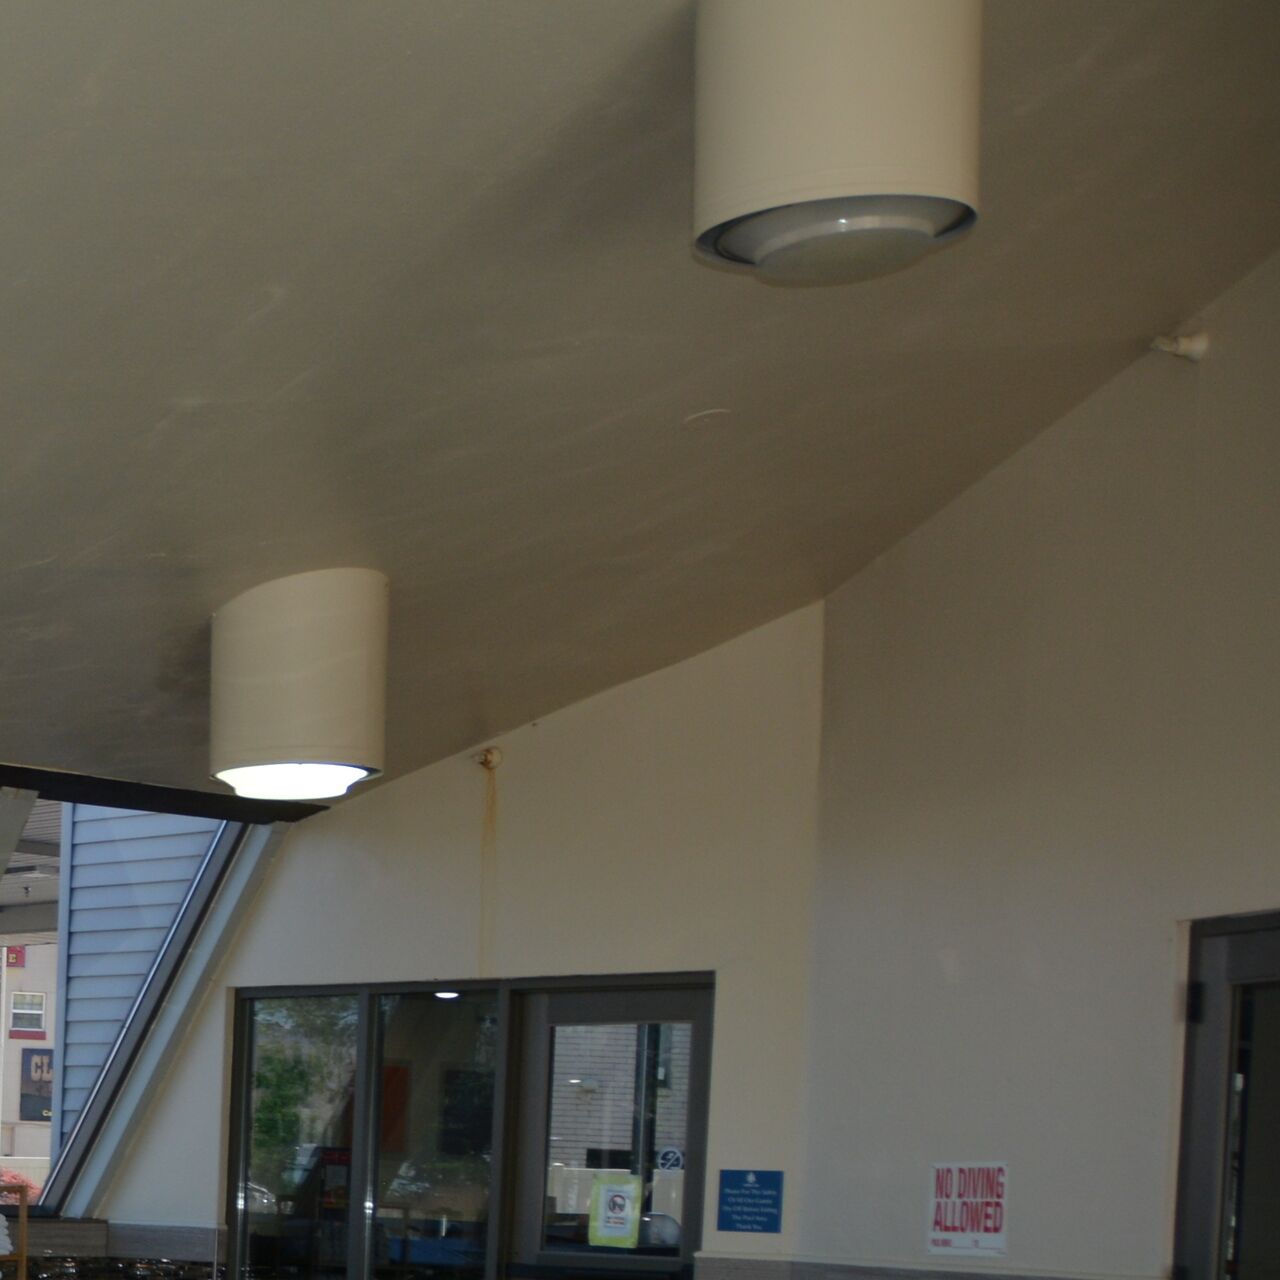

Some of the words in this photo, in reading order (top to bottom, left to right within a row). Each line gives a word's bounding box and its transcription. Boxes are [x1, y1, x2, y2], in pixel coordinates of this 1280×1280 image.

[935, 1167, 953, 1199] NO
[957, 1166, 1005, 1199] DIVING
[933, 1201, 1003, 1233] ALLOWED
